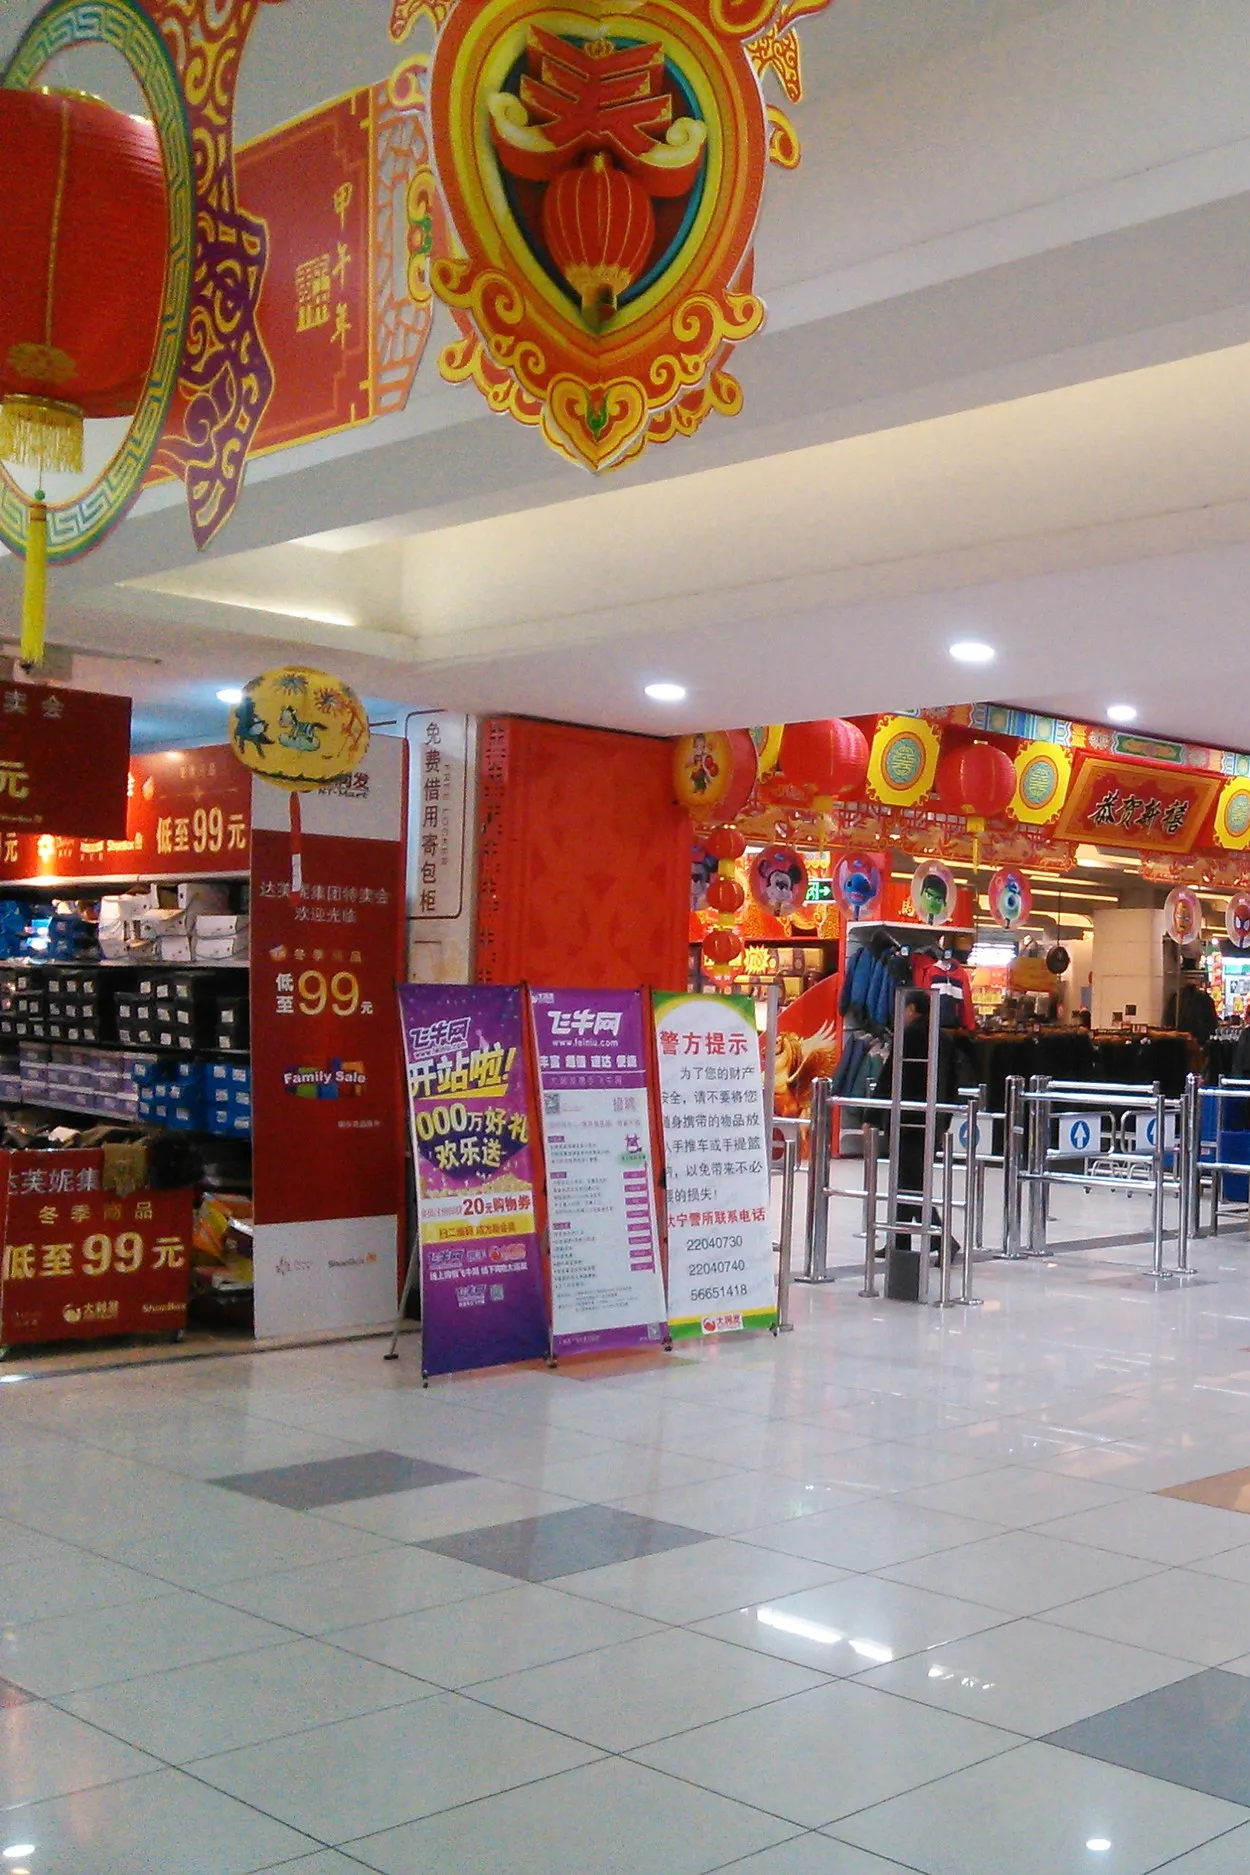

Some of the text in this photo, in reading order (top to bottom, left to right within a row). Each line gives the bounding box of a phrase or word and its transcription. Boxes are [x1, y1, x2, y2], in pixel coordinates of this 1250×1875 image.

[331, 182, 353, 349] 甲午年
[419, 722, 441, 912] 免费借用寄包柜
[1087, 789, 1189, 835] 恭贺新禧
[156, 807, 246, 854] 低至99元
[295, 906, 356, 923] 欢迎光临
[409, 1016, 471, 1050] 飞牛网
[547, 1008, 623, 1036] 飞牛网
[552, 1039, 618, 1047] www.feiniu.com
[660, 1030, 748, 1055] 警方提示
[284, 1071, 367, 1084] Family Sale
[681, 1066, 755, 1080] 为了您的财产
[416, 1102, 529, 1143] 000万好礼
[434, 1136, 501, 1170] 欢乐送
[38, 1201, 153, 1224] 冬季尚品
[463, 1194, 531, 1216] 20元购物券
[2, 1231, 185, 1280] 低至99元
[687, 1235, 743, 1251] 22040730
[689, 1260, 745, 1276] 22040740
[691, 1284, 748, 1301] 56651418
